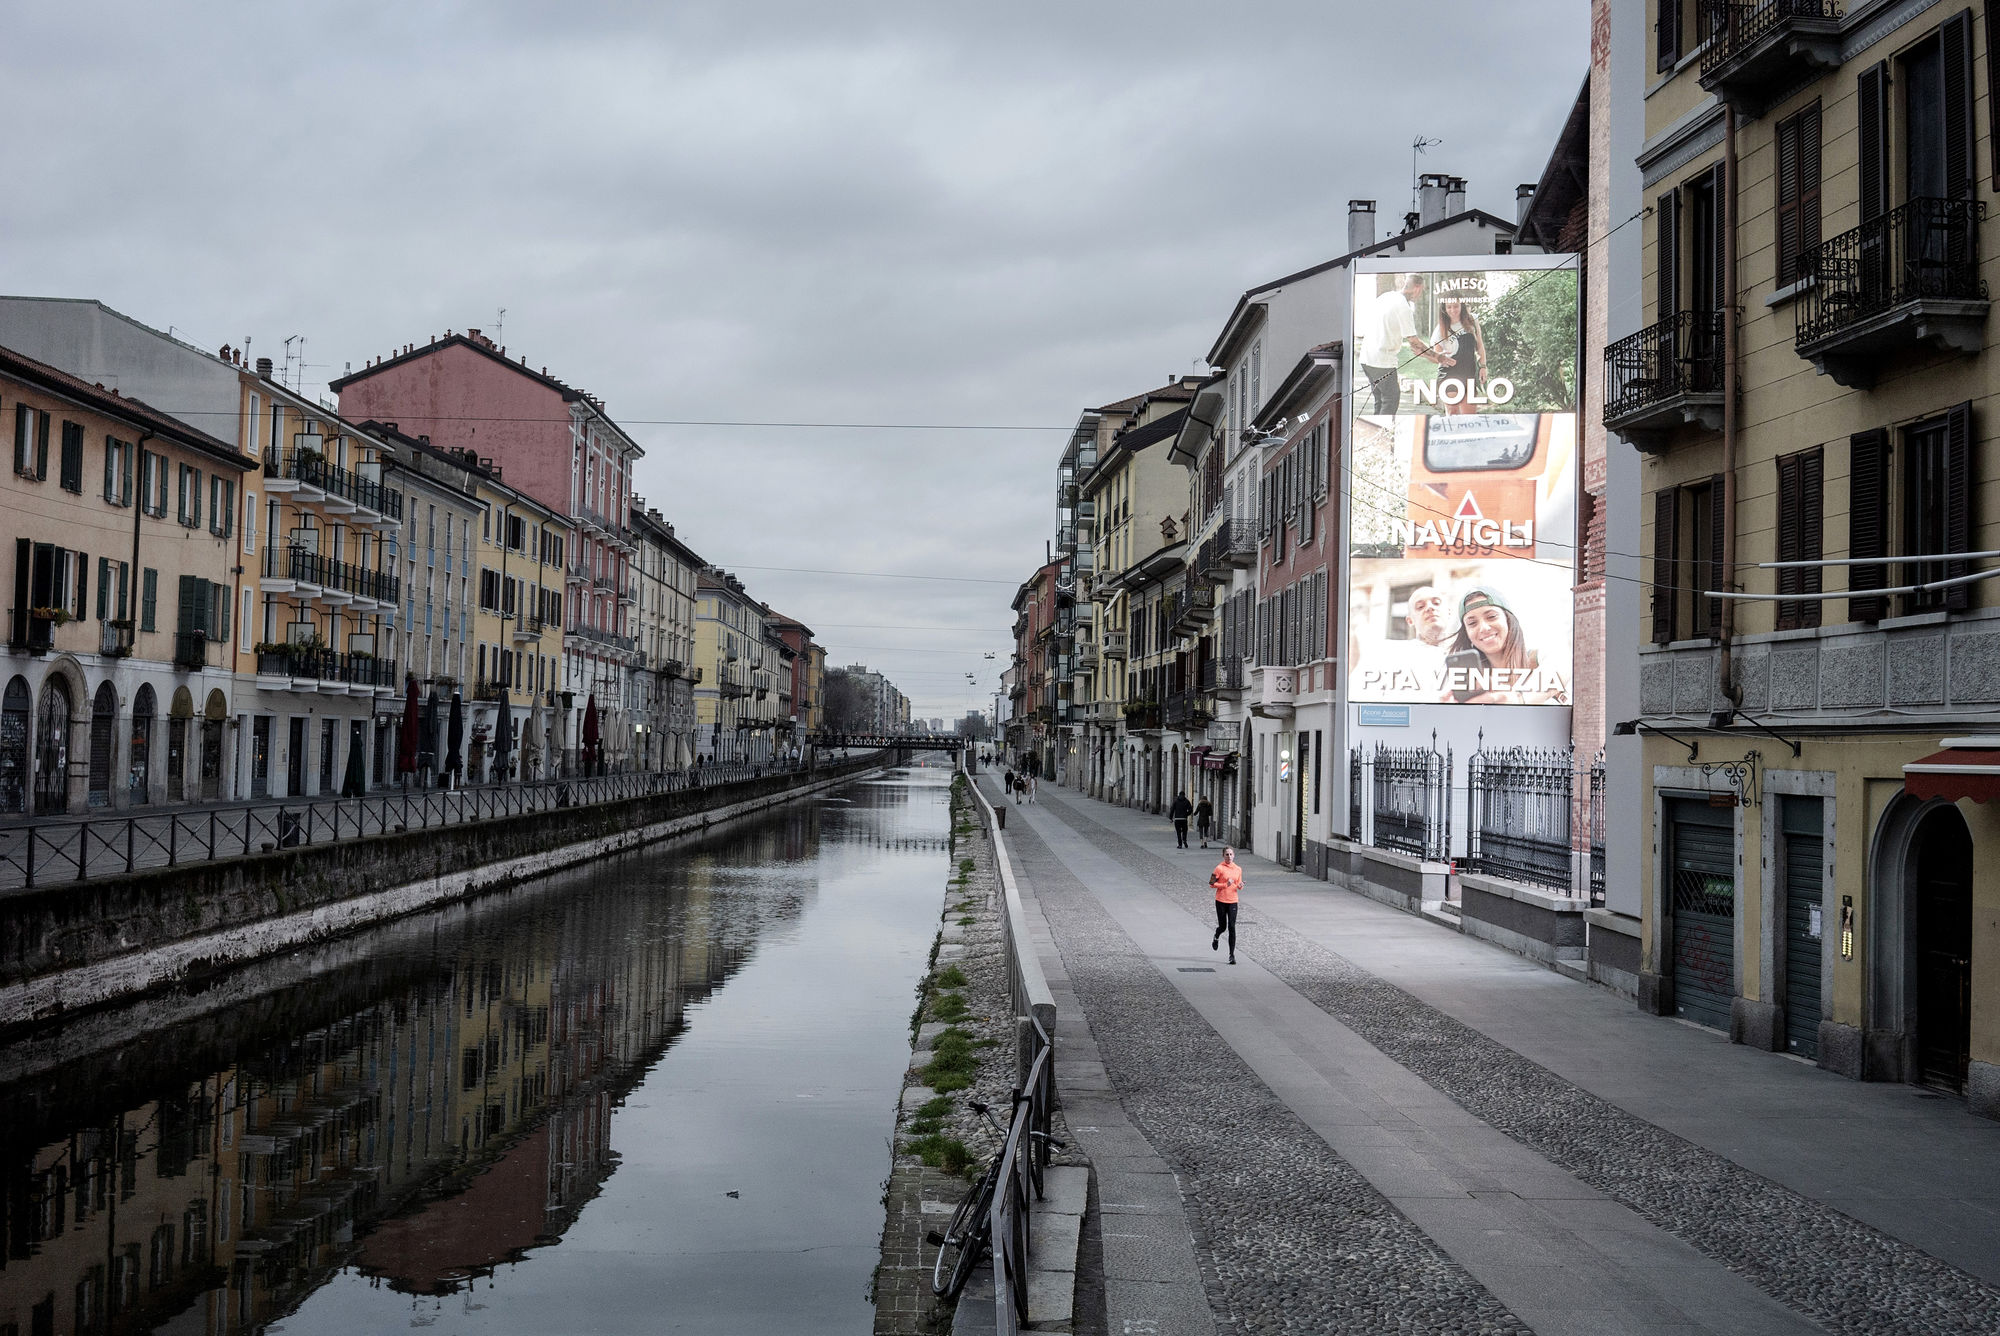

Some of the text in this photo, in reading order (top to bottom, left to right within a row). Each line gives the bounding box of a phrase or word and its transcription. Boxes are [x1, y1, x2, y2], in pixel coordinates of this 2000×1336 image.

[1433, 277, 1488, 294] JAMESO
[1414, 377, 1514, 405] NOLO
[1391, 519, 1533, 546] NAVIGLI
[1432, 666, 1567, 692] VENEZIA
